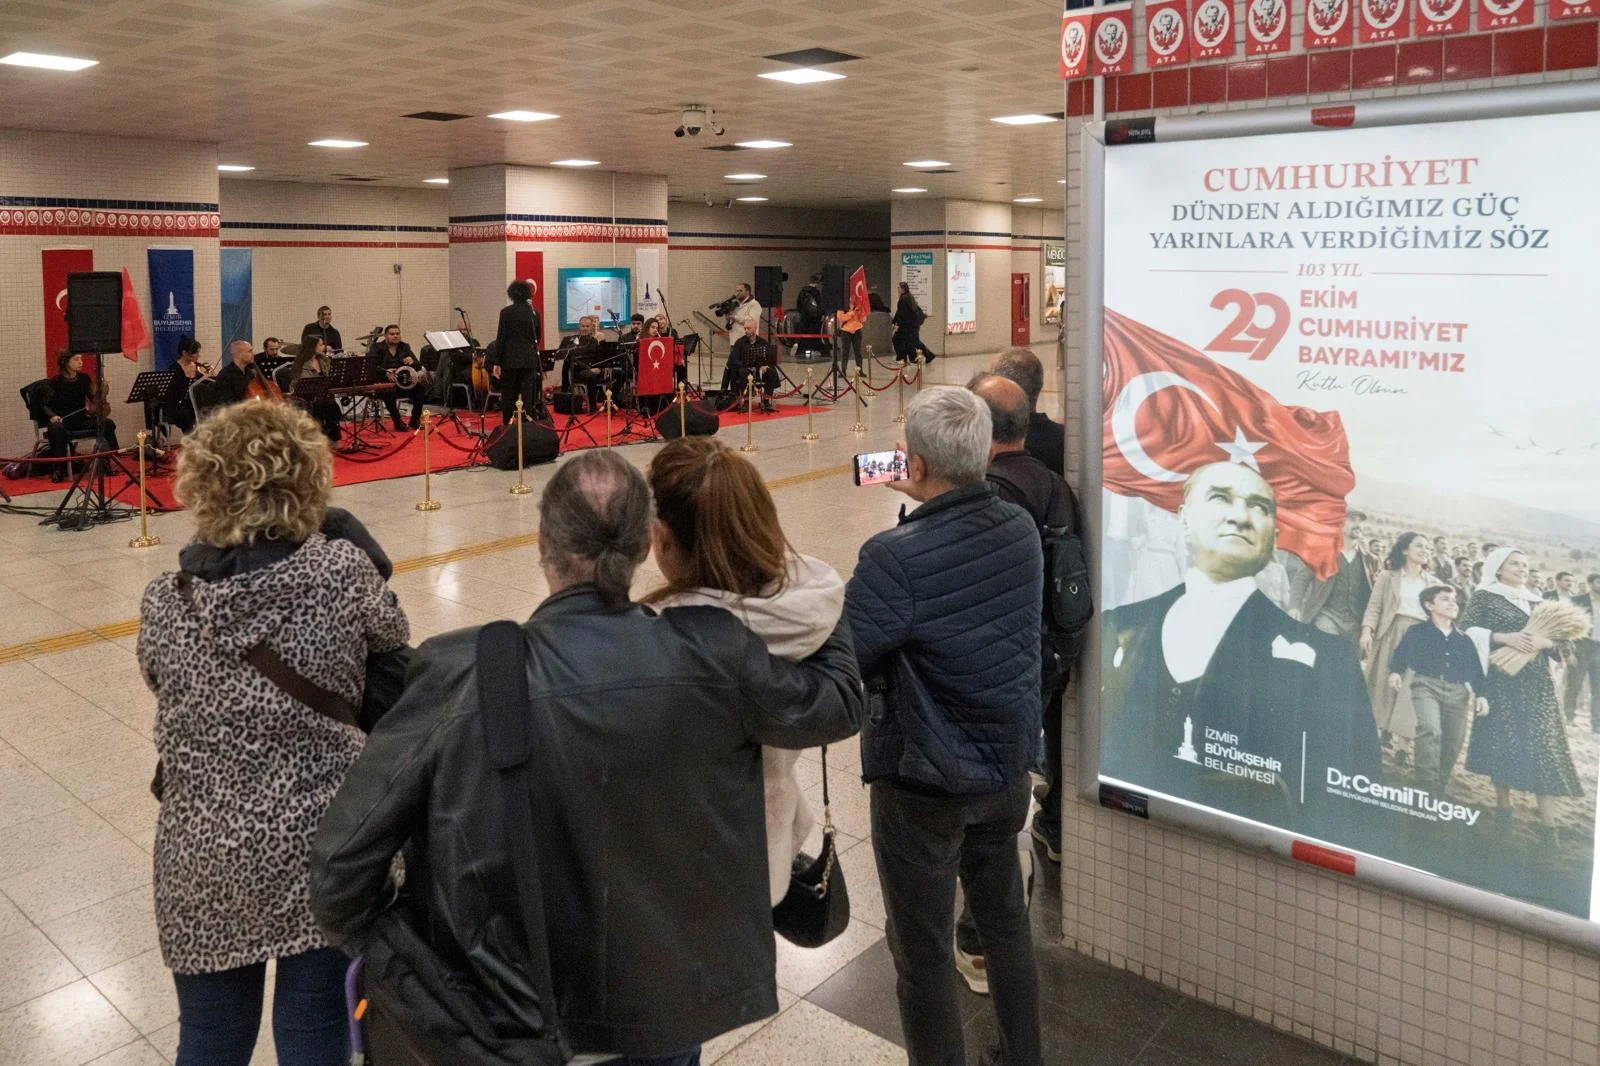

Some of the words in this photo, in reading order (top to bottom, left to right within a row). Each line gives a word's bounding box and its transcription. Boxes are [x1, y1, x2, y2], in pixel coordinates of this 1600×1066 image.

[1562, 6, 1592, 16] ATA
[1426, 23, 1453, 32] ATA
[1490, 16, 1519, 26] ATA
[1313, 37, 1338, 45] ATA
[1370, 30, 1395, 39] ATA
[1200, 48, 1221, 57] ATA
[1255, 43, 1278, 52] ATA
[1156, 56, 1177, 65] ATA
[1064, 69, 1080, 77] ATA
[1203, 155, 1478, 192] CUMHURİYET
[1172, 200, 1279, 221] DÜNDEN
[1287, 196, 1444, 219] ALDIĞIMIZ
[1452, 192, 1520, 222] GÜÇ
[1150, 231, 1294, 249] YARINLARA
[1300, 225, 1482, 249] VERDİĞİMİZ
[1490, 224, 1549, 249] SÖZ
[1296, 263, 1326, 277] 103
[1332, 263, 1363, 277] YIL
[1300, 285, 1357, 309] EKİM
[1203, 288, 1291, 361] 29
[1298, 316, 1468, 343] CUMHURİYET
[1296, 370, 1344, 391] Kutlu
[1205, 726, 1239, 746] İZMİR
[1205, 743, 1282, 773] BÜYÜKŞEHİR
[1204, 756, 1276, 786] BELEDİYESİ
